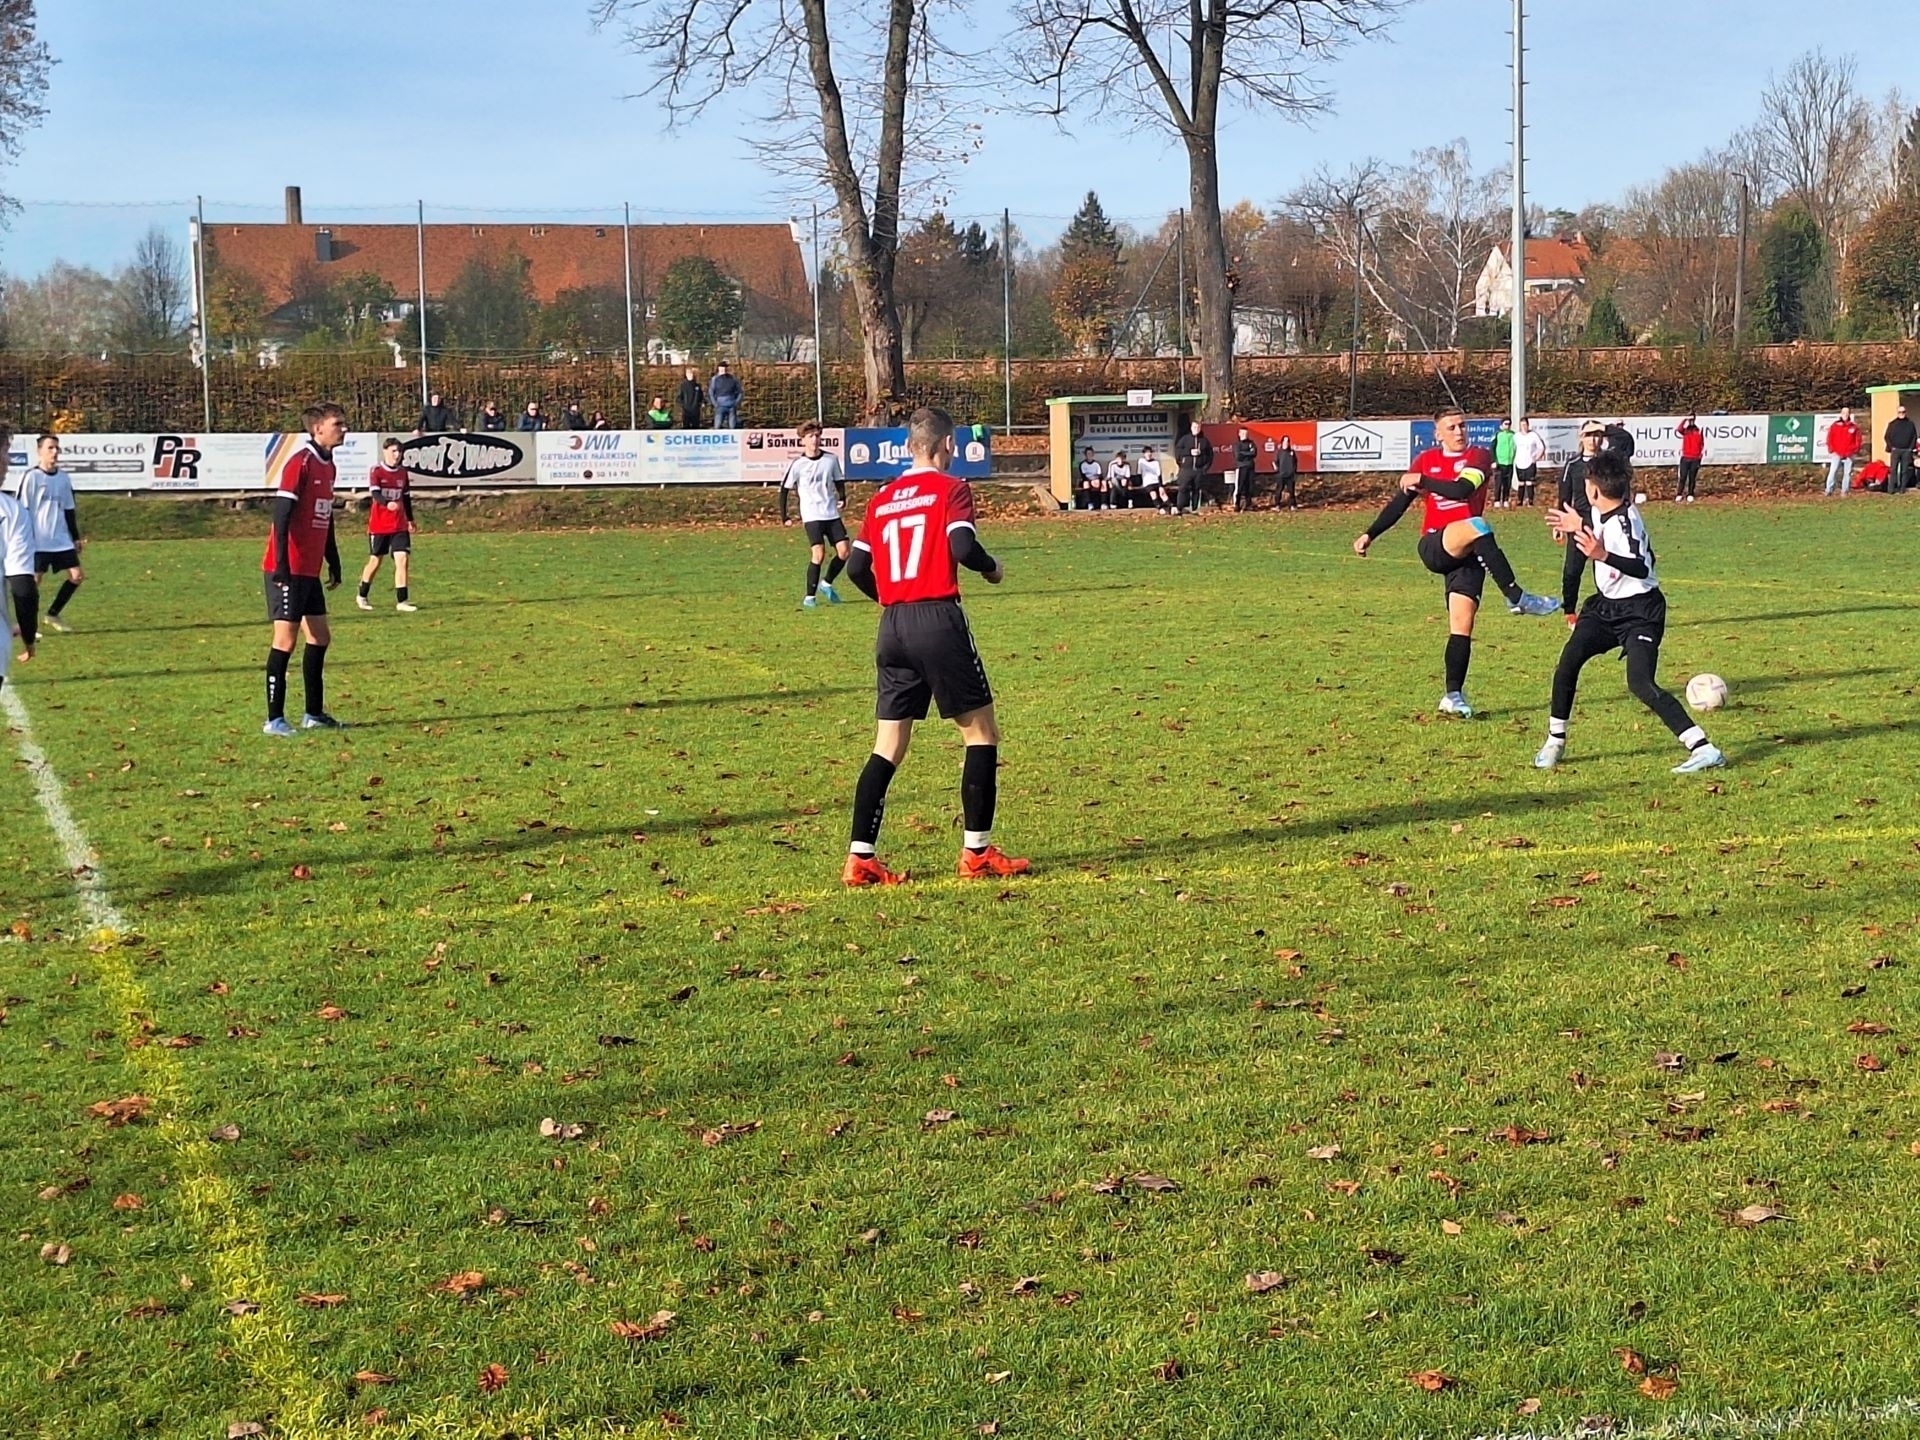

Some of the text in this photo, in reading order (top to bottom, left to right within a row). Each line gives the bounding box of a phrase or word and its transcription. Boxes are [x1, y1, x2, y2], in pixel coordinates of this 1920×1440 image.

[1636, 425, 1757, 439] HUTCNSON
[664, 434, 739, 445] SCHERDEL
[767, 438, 839, 448] SONNEERG
[1331, 436, 1370, 450] ZVM
[57, 442, 145, 455] stro Groß
[882, 513, 926, 583] 17
